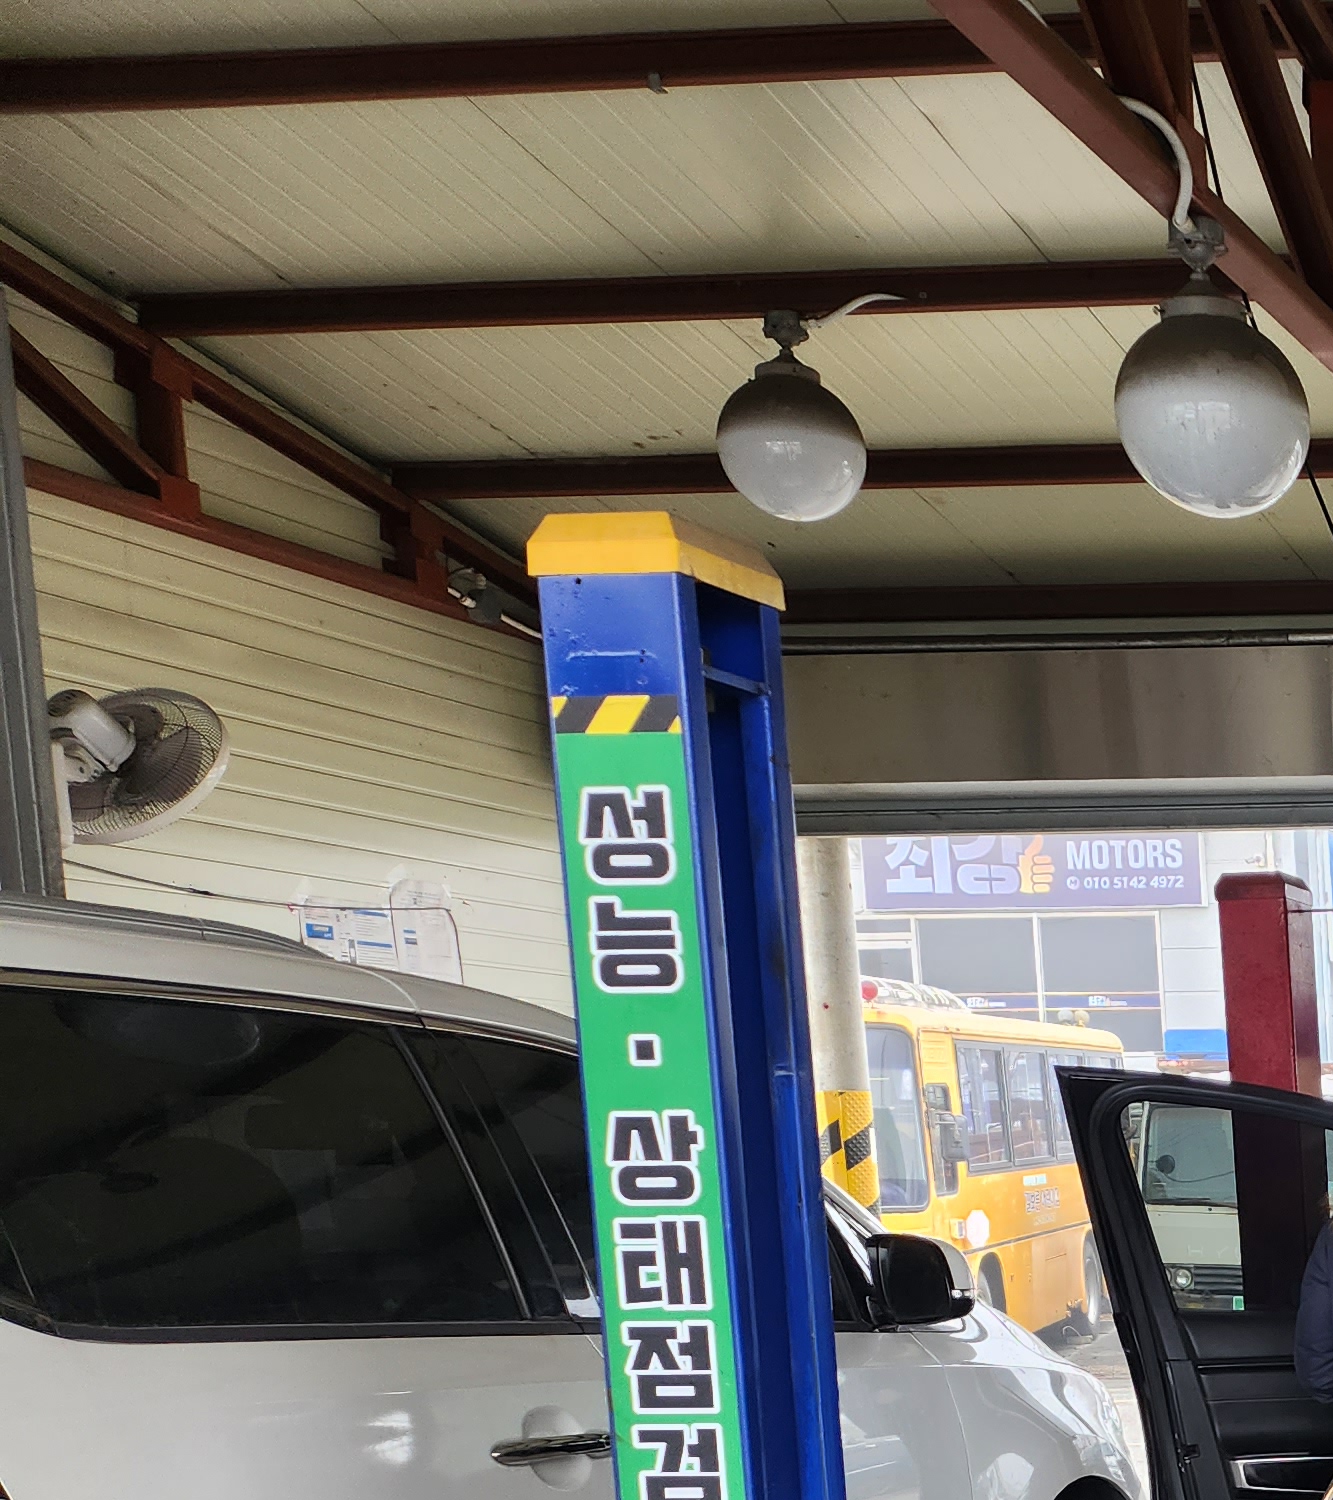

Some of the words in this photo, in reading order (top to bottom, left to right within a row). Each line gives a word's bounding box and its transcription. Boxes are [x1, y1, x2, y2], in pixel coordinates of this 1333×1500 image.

[1066, 838, 1183, 870] MOTORS
[1083, 876, 1110, 889] 010
[1112, 876, 1147, 889] 5142
[1149, 875, 1184, 888] 4972
